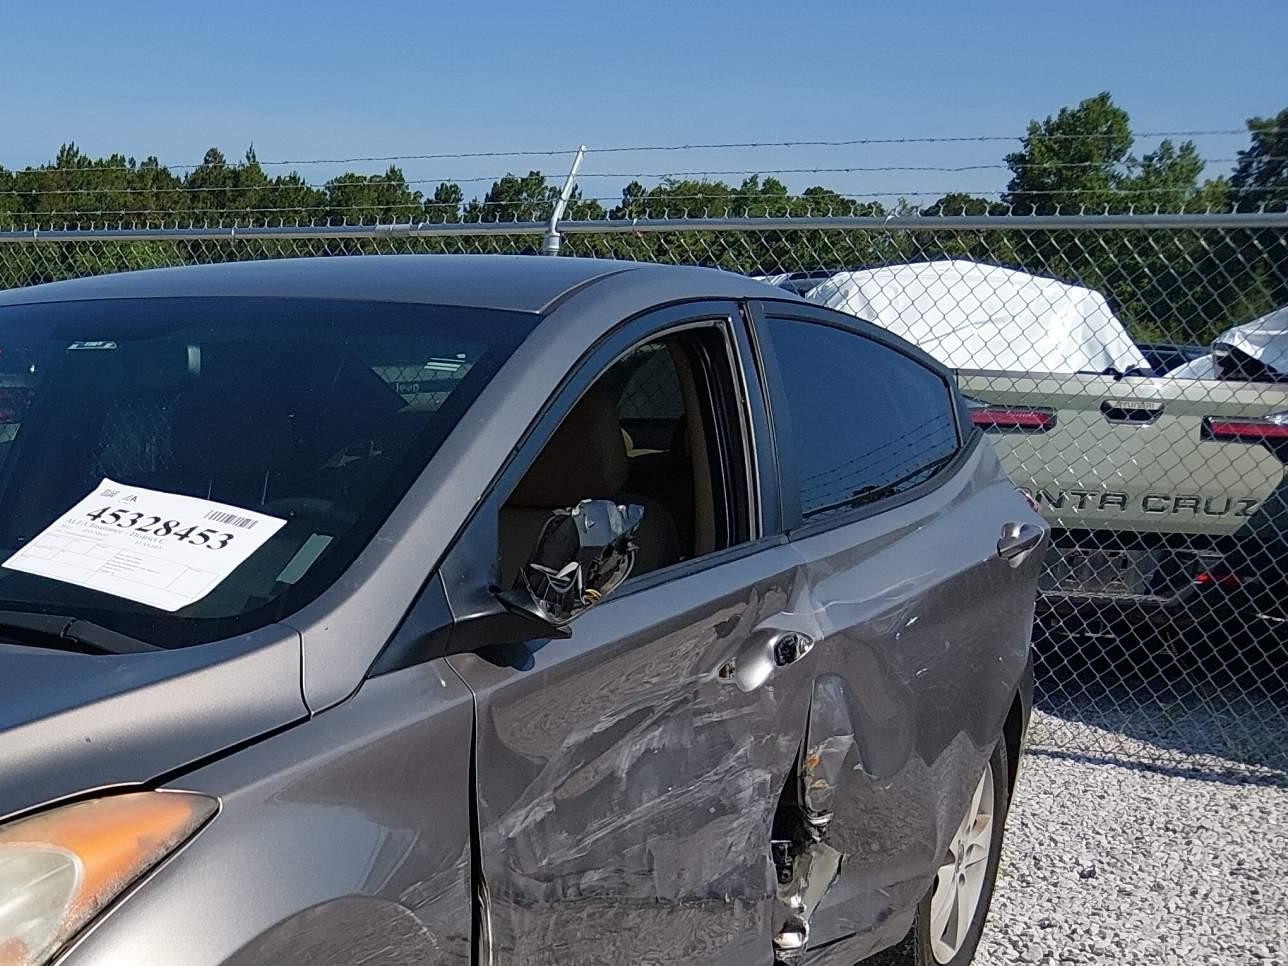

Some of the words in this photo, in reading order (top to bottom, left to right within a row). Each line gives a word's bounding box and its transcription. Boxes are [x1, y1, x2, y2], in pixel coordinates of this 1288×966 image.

[1014, 487, 1129, 513] NTA
[1141, 494, 1260, 518] CRUZ
[86, 505, 235, 550] 45328453
